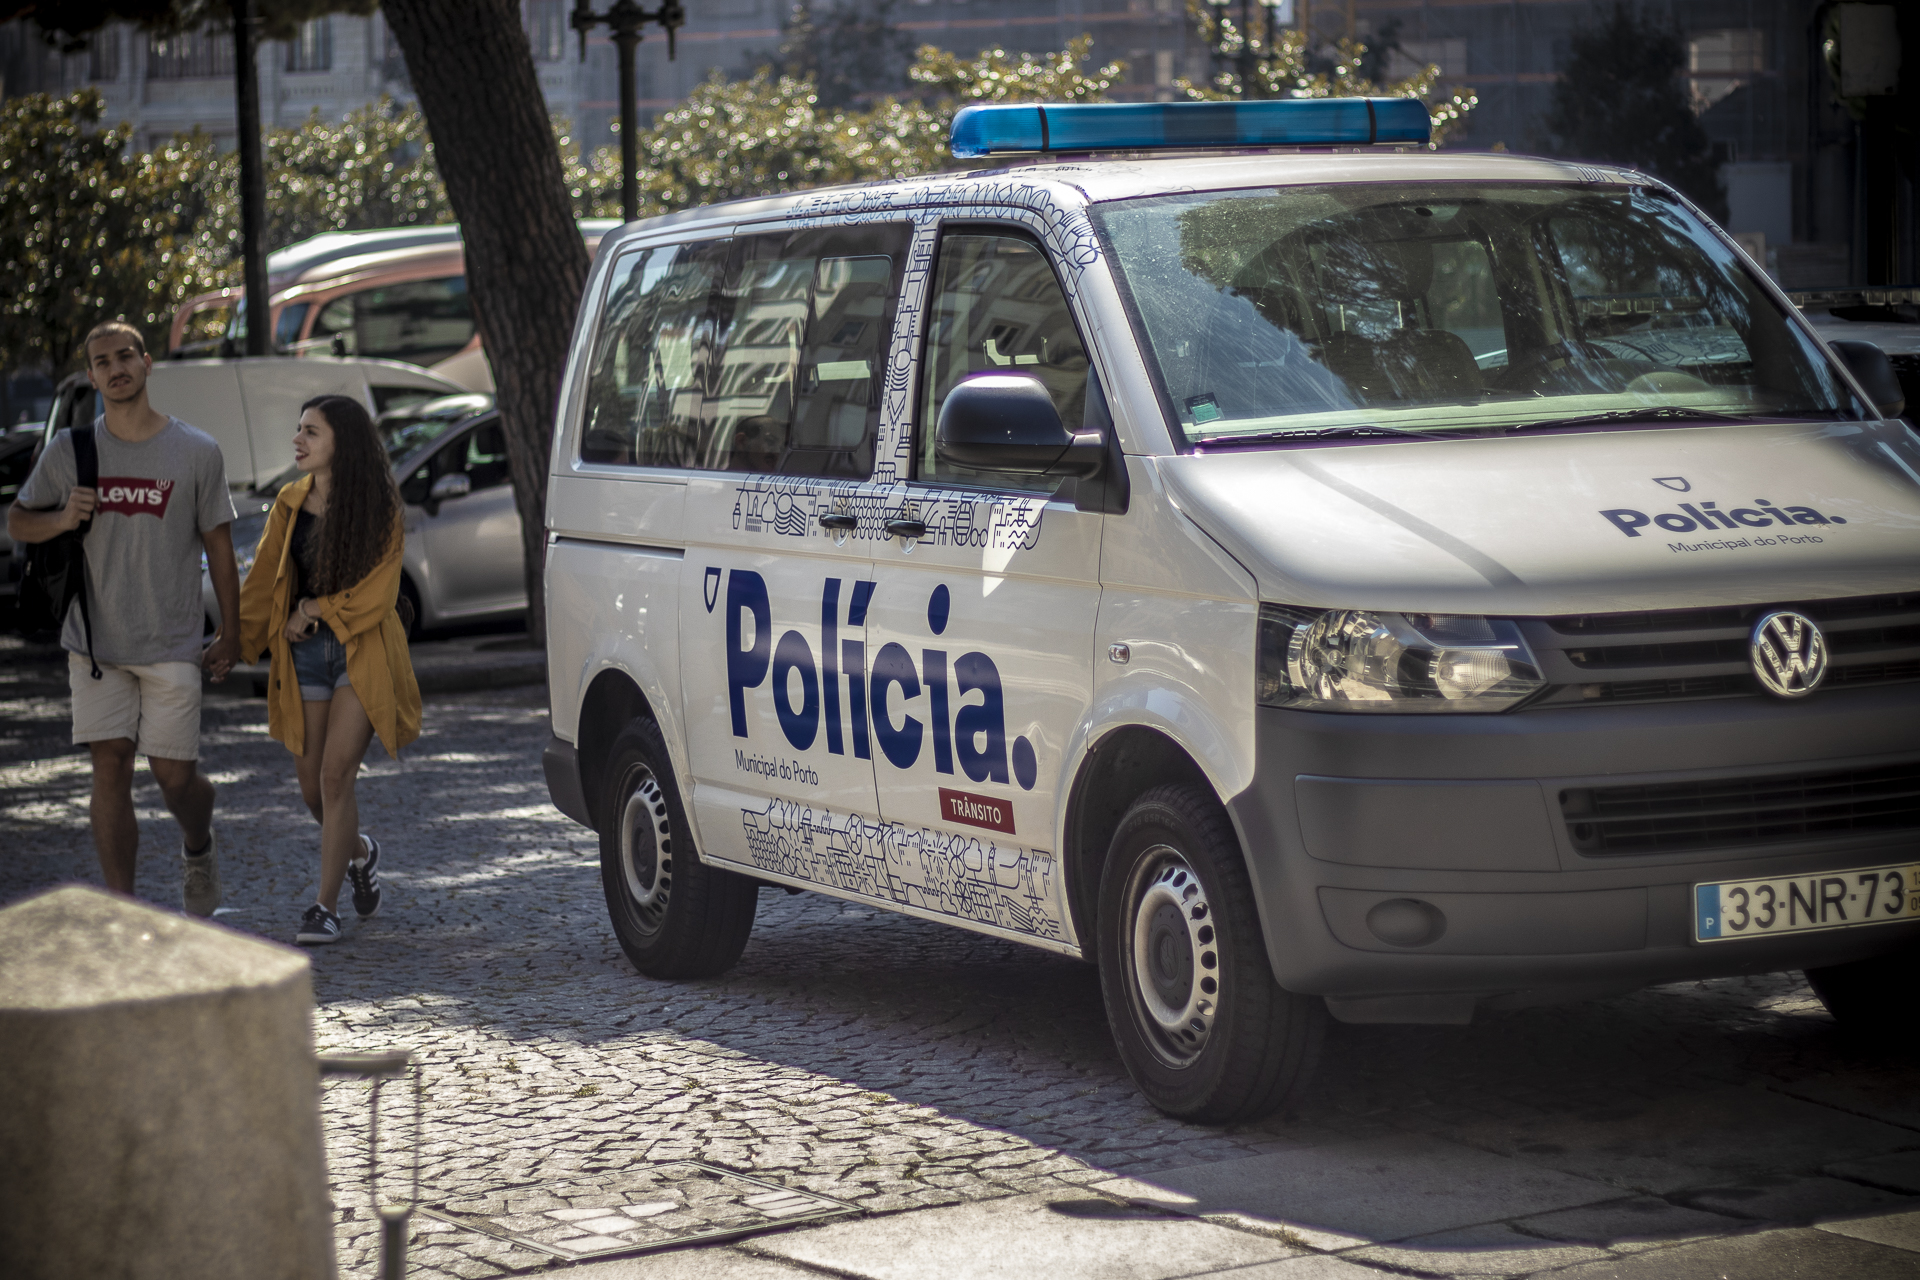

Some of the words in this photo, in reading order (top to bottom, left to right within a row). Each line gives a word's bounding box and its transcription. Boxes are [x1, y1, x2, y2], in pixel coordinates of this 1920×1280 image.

[1598, 498, 1848, 538] Polícia.
[1667, 537, 1752, 553] Municipal
[1753, 536, 1777, 547] do
[1776, 534, 1824, 545] Porto
[726, 569, 1038, 791] Polícia.
[735, 749, 778, 780] Municipal
[780, 758, 792, 780] do
[793, 760, 819, 786] Porto
[950, 796, 1002, 824] TRÂNSITO
[1706, 917, 1715, 930] P
